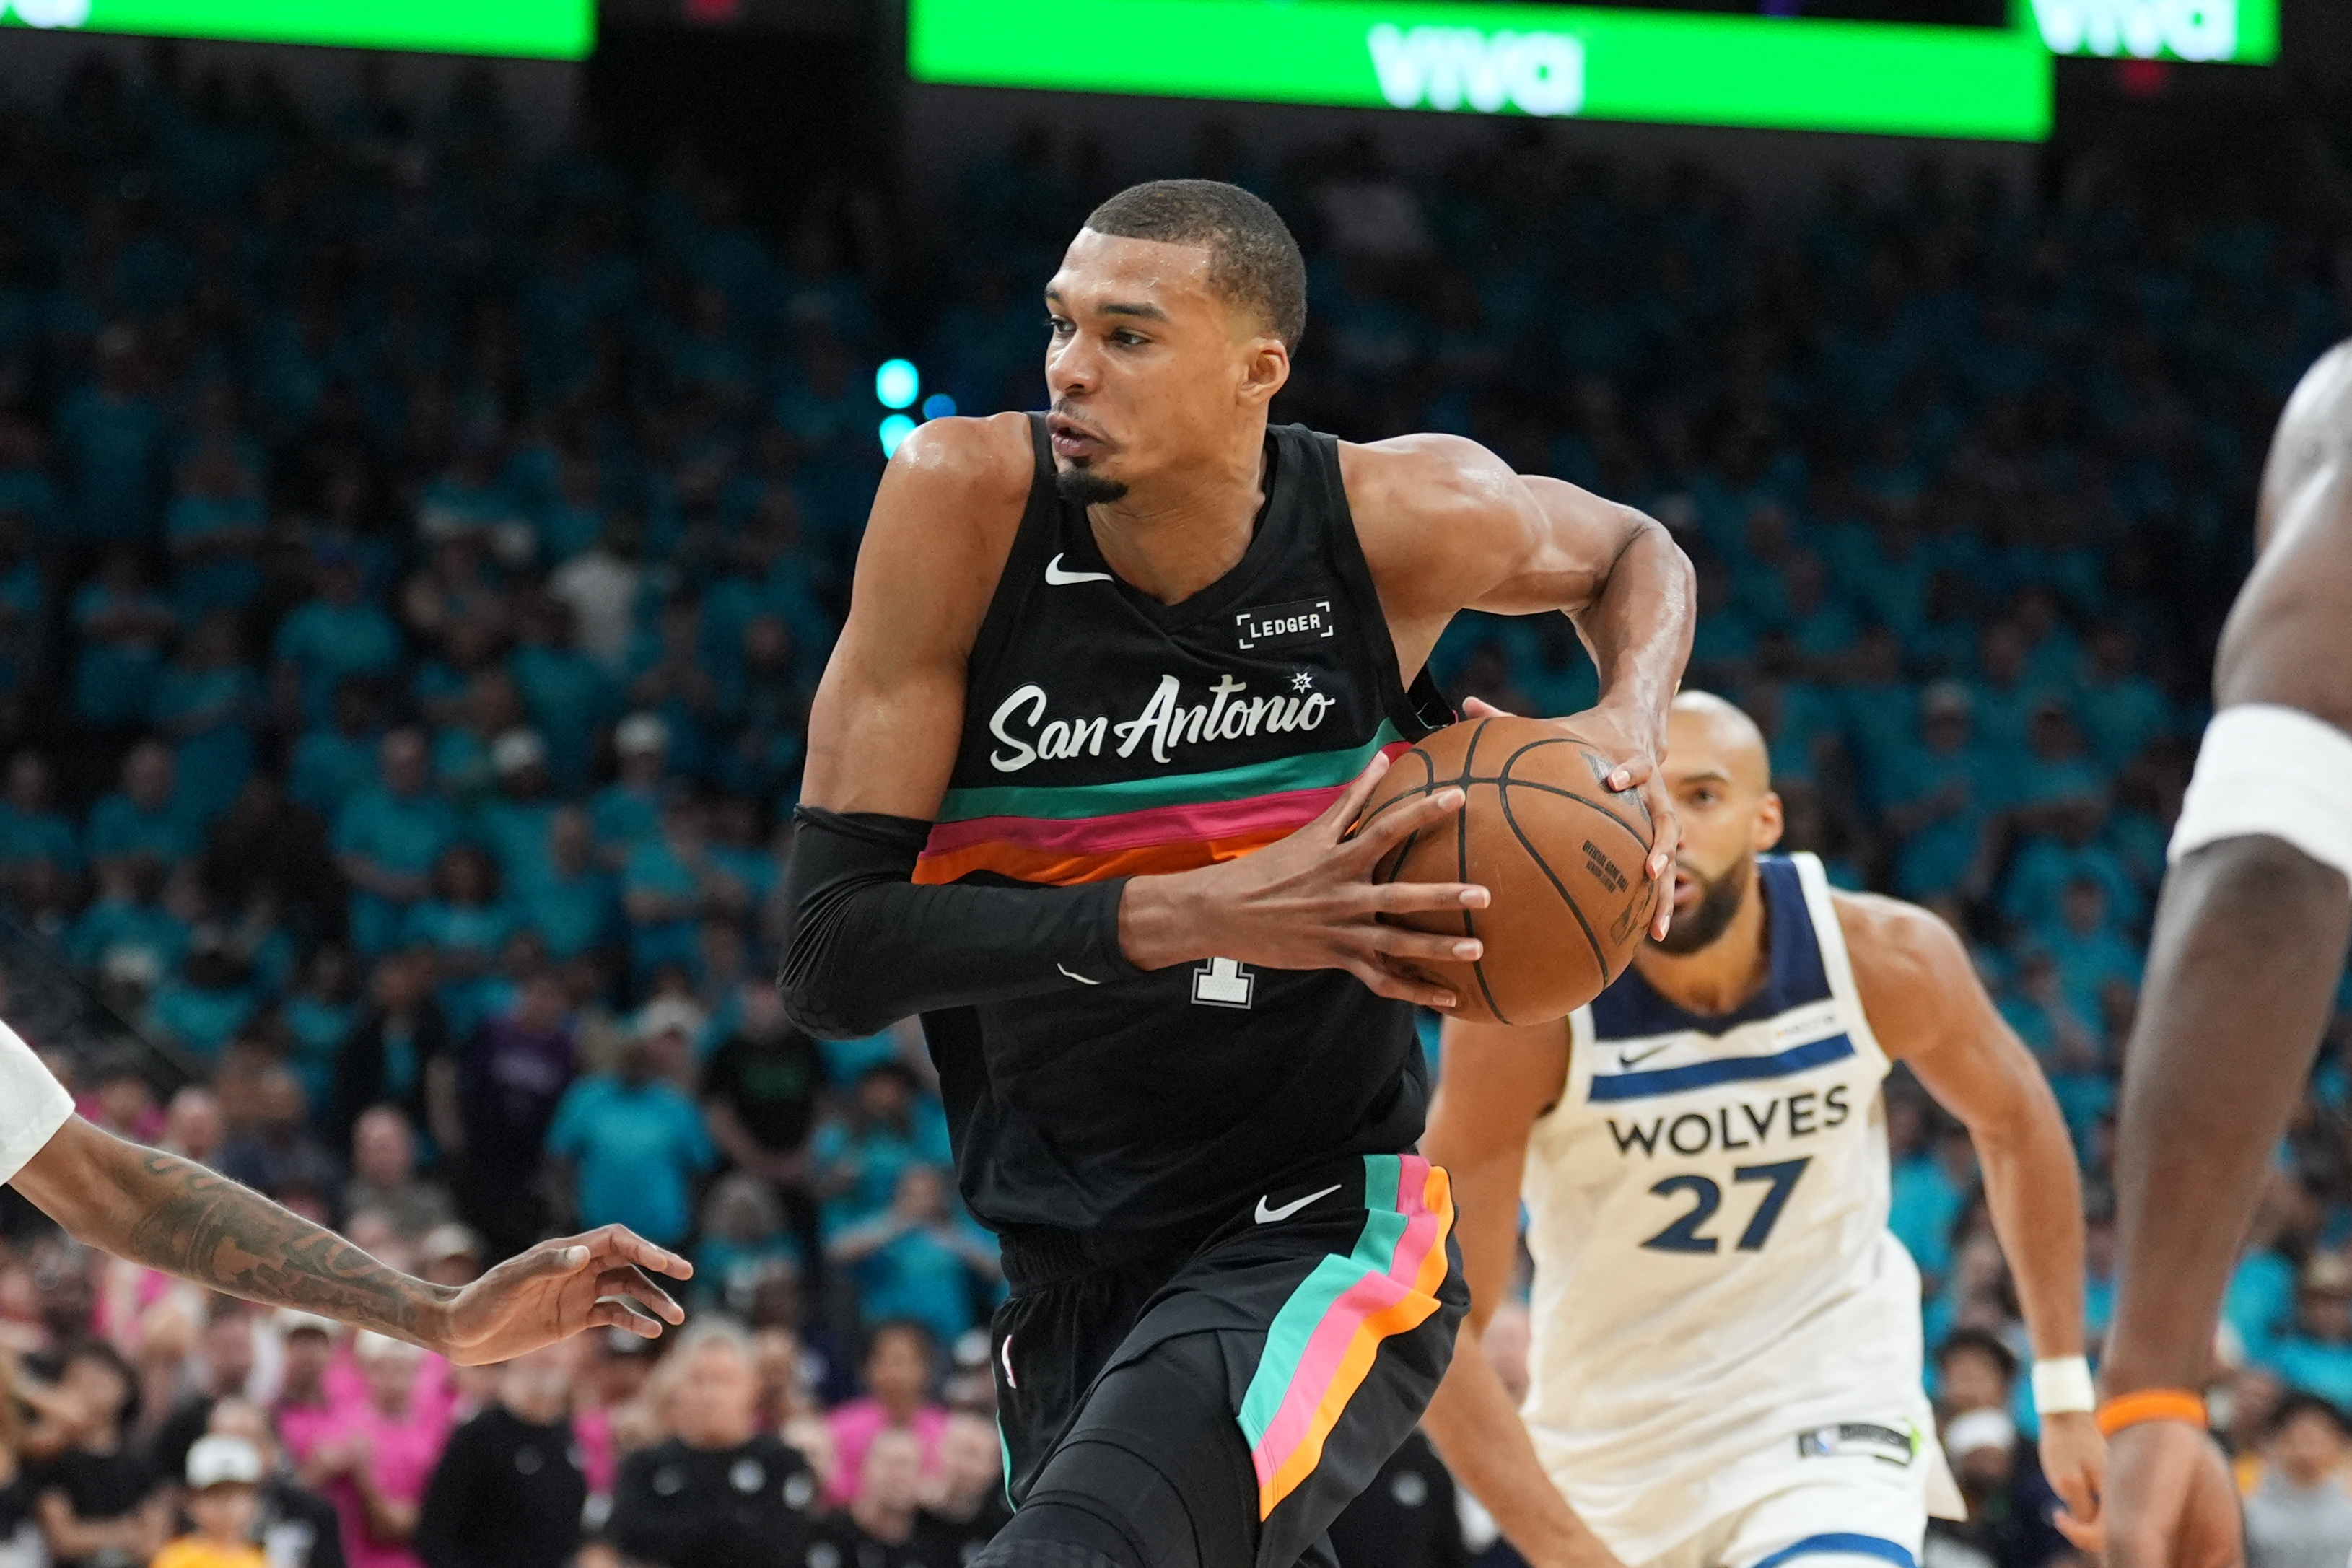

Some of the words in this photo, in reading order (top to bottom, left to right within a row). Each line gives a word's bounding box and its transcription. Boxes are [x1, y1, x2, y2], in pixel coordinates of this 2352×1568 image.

[1250, 613, 1321, 639] LEDGER
[989, 684, 1109, 773] San
[1113, 671, 1336, 764] Antonio
[1607, 1084, 1850, 1159] WOLVES
[1638, 1155, 1814, 1254] 27
